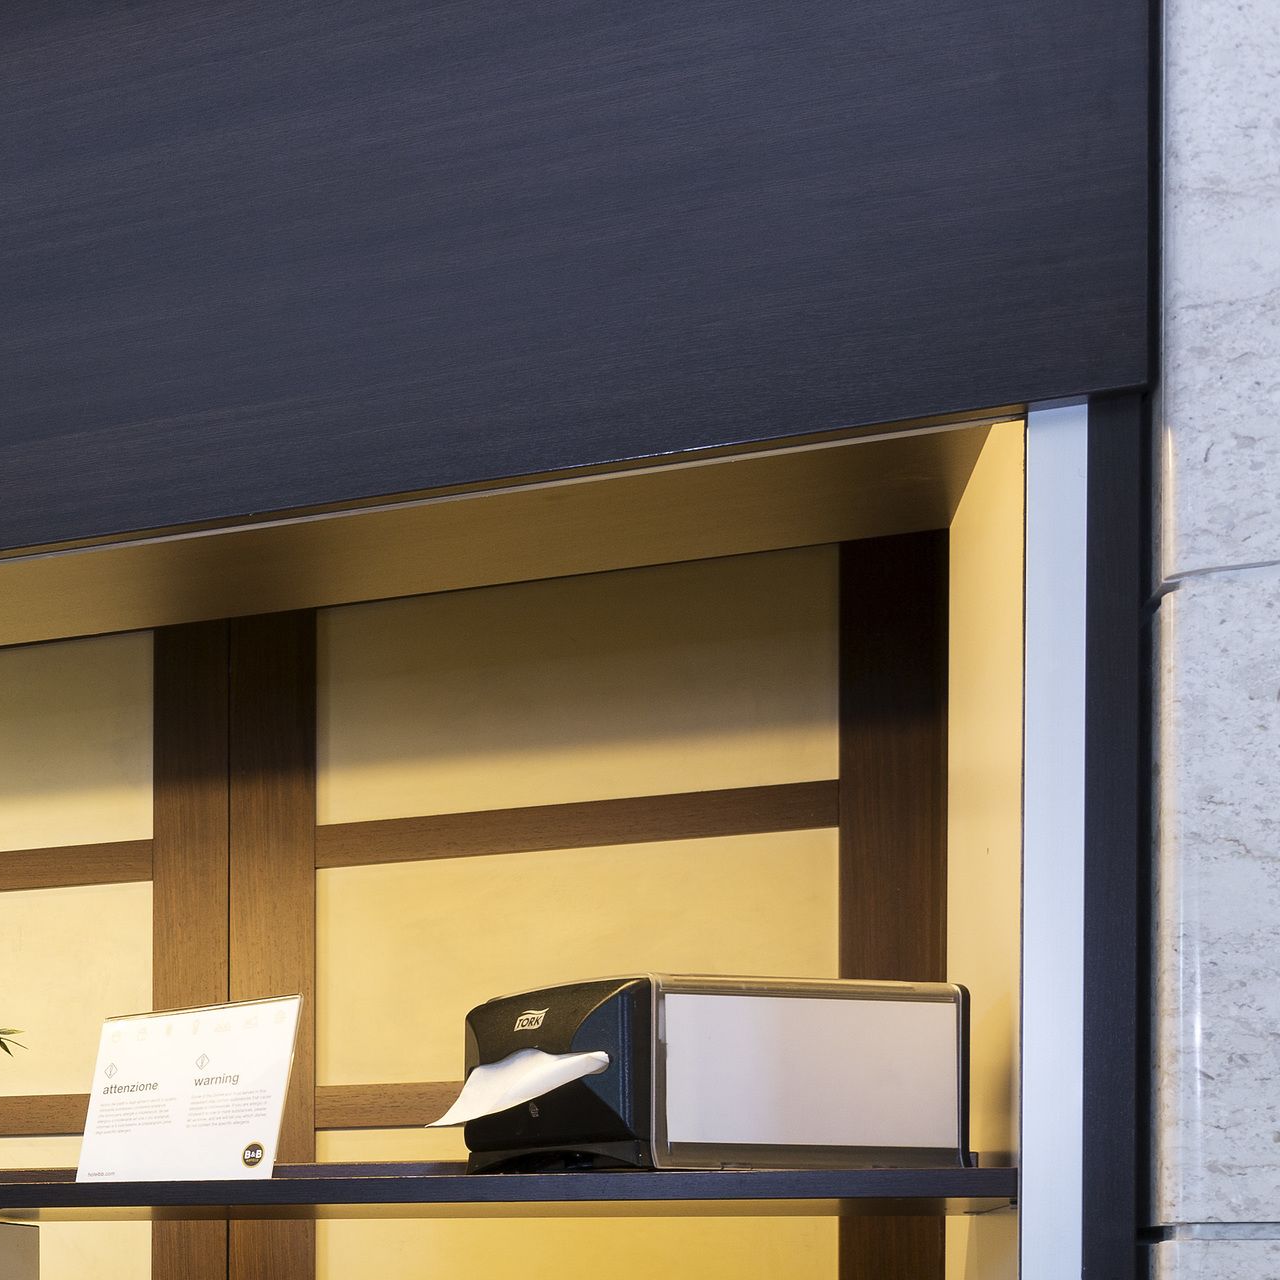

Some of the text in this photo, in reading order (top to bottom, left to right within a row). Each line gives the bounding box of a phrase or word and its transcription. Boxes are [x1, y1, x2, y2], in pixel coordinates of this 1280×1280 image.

[517, 1015, 542, 1028] TORK
[194, 1073, 240, 1086] warning
[102, 1081, 159, 1095] attenzione
[244, 1149, 262, 1160] B&B
